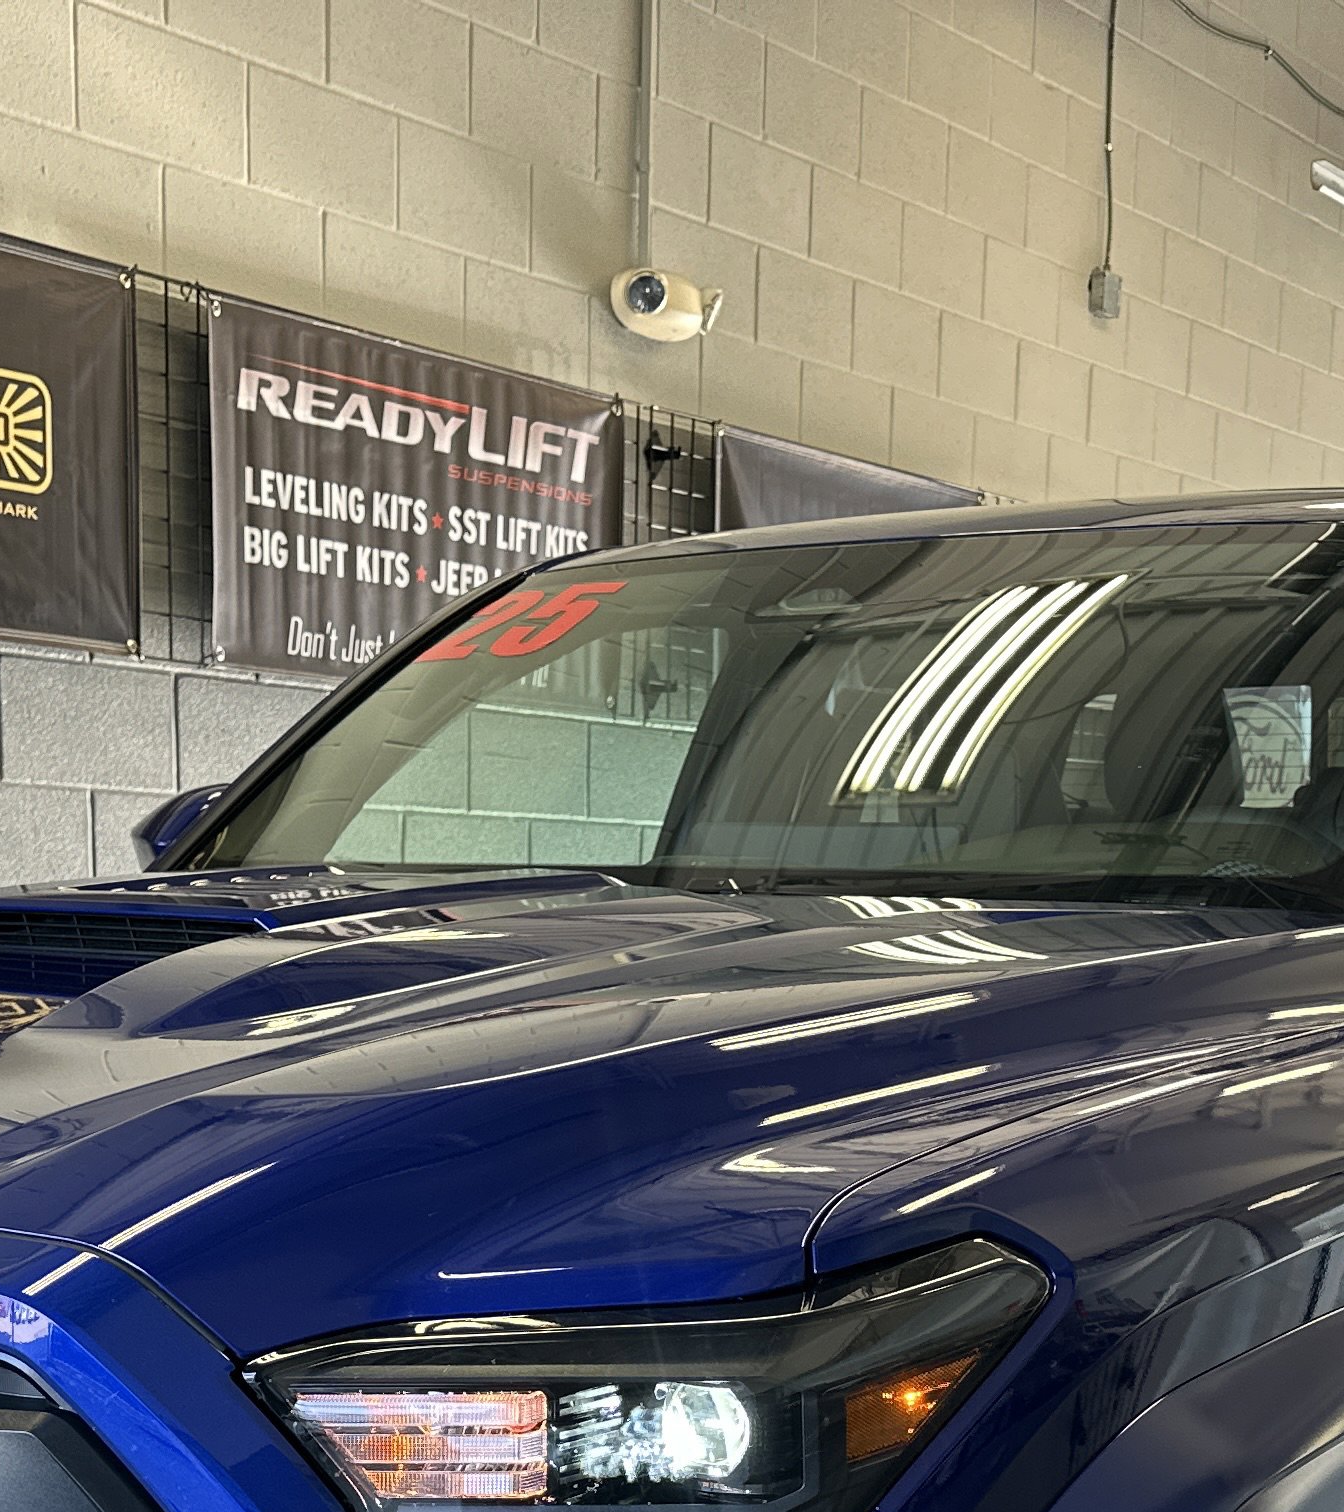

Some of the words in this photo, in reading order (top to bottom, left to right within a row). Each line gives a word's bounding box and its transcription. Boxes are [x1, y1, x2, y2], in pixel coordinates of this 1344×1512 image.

[237, 367, 600, 484] READYLIFT
[244, 466, 365, 525] LEVELING
[373, 491, 427, 536] KITS
[448, 505, 491, 546] SST
[496, 514, 542, 555] LIFT
[545, 524, 589, 558] KITS
[447, 464, 592, 506] SUSPENSIONS
[244, 525, 288, 569] BIG
[296, 533, 348, 579] LIFT
[356, 545, 410, 589] KITS
[287, 615, 337, 659] Don't
